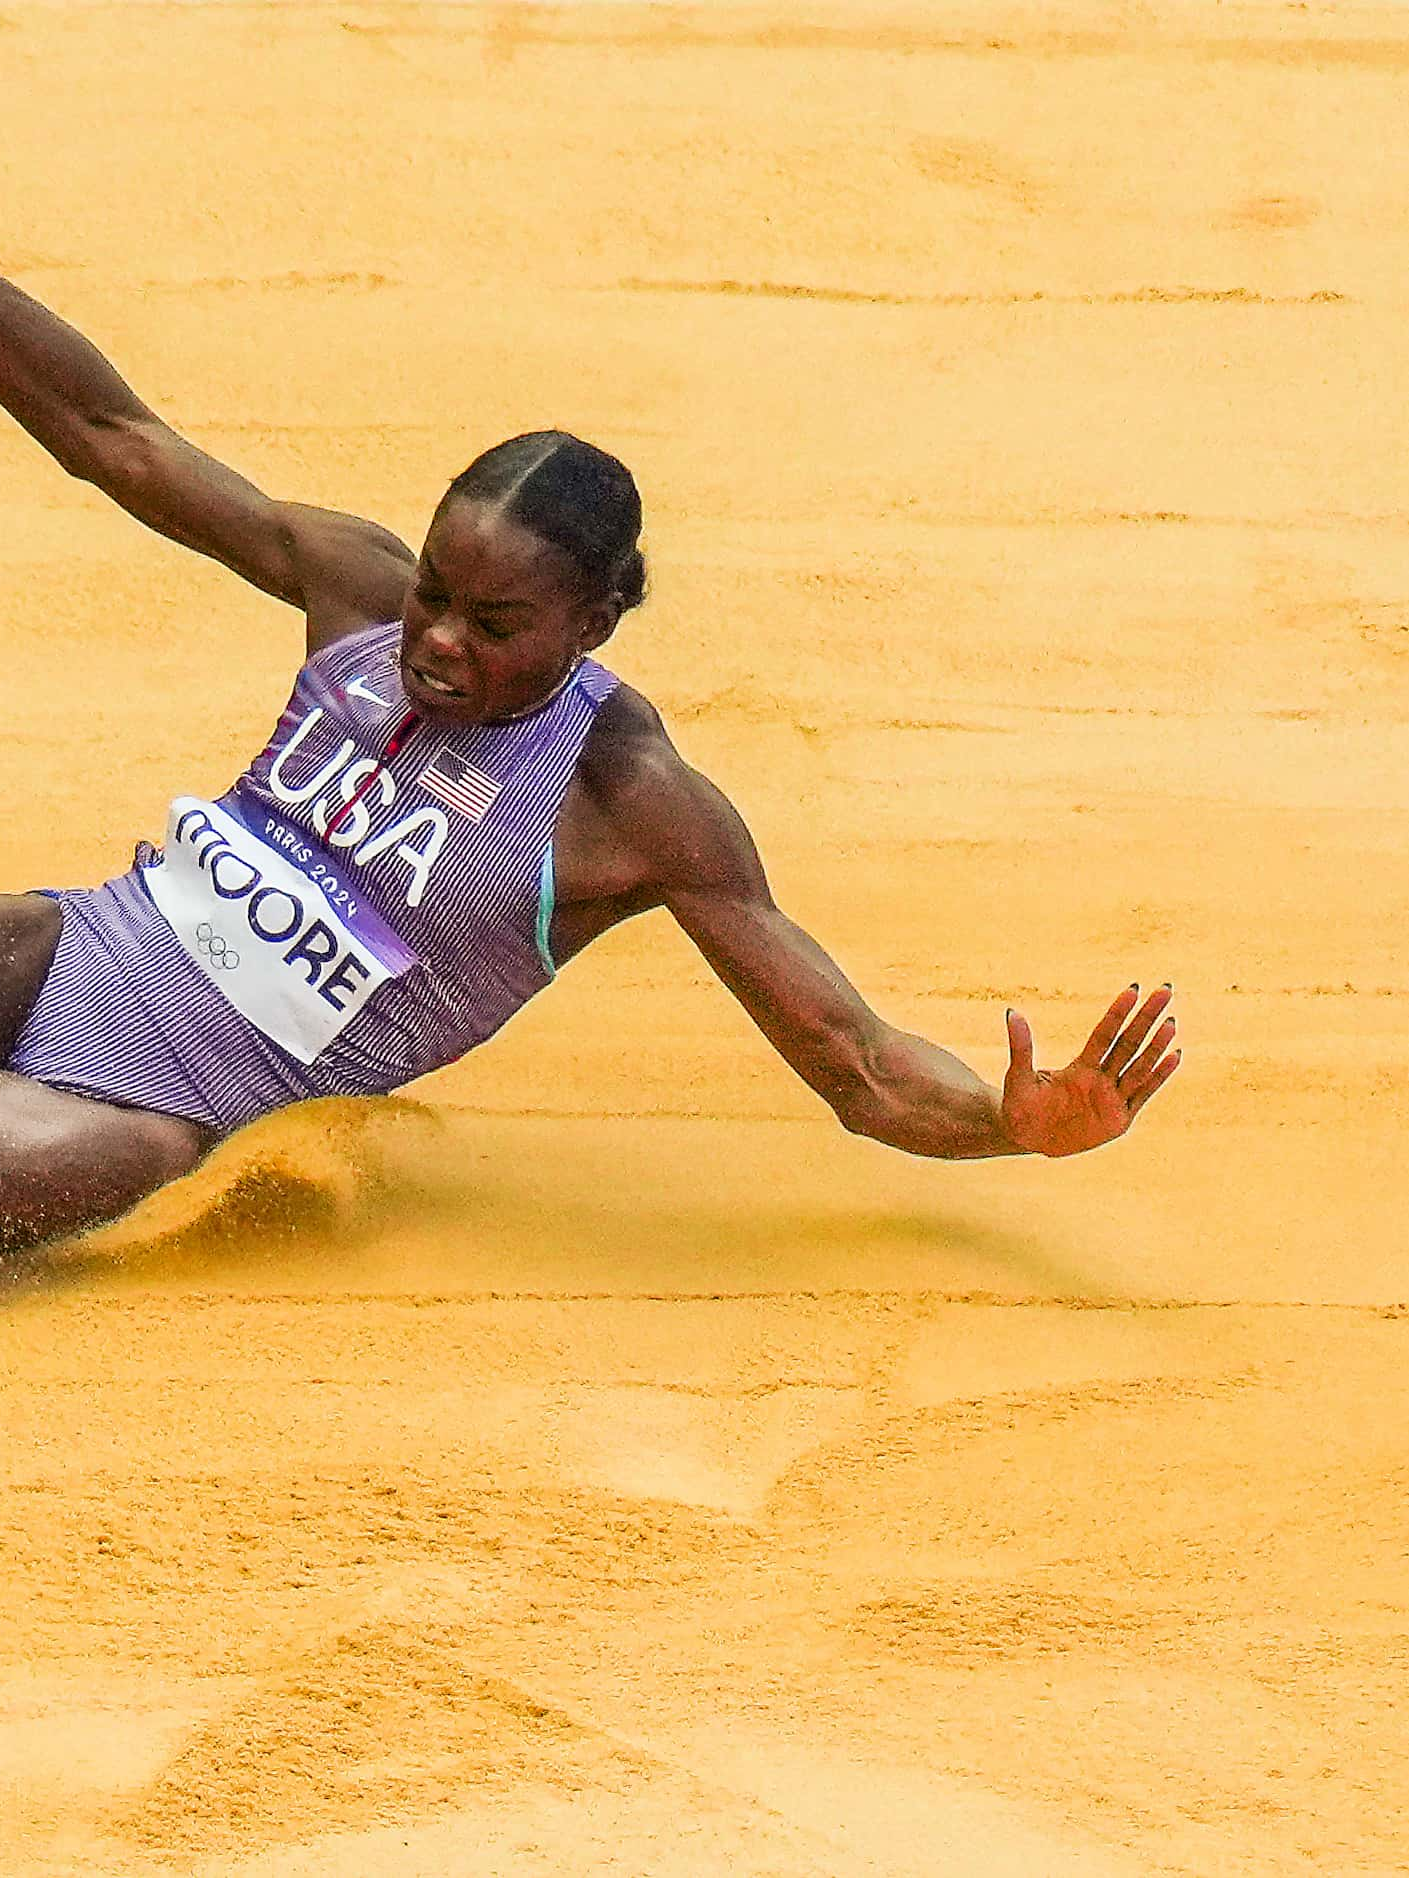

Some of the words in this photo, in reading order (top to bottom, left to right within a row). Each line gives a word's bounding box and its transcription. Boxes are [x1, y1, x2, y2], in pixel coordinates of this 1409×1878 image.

[265, 818, 313, 863] PARIS
[311, 864, 359, 920] 2024
[269, 708, 449, 908] USA
[175, 809, 372, 1013] MOORE
